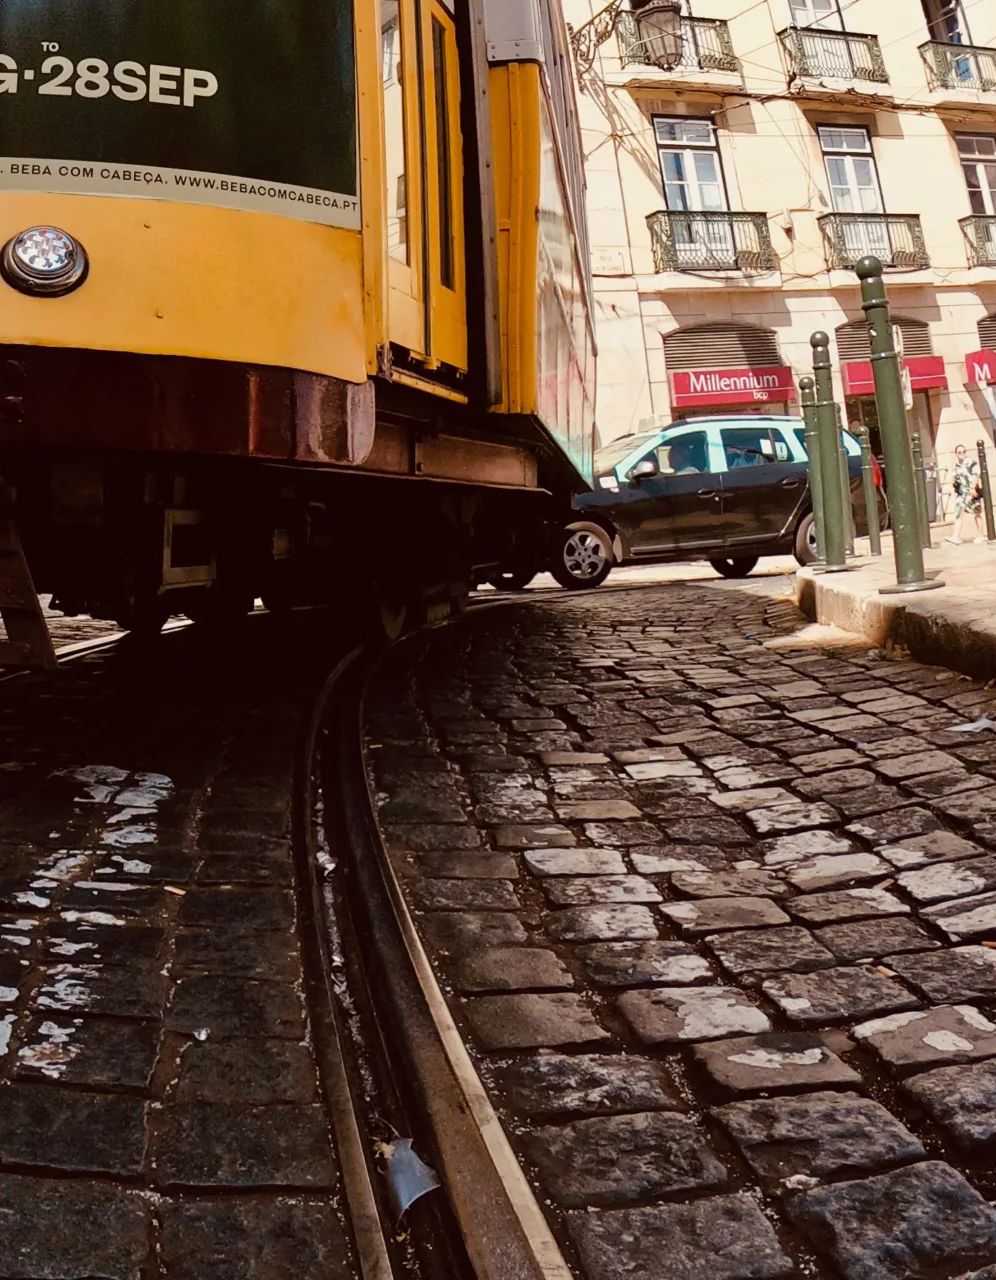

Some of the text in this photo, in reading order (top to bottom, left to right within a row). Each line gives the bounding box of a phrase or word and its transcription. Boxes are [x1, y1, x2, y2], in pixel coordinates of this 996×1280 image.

[41, 42, 59, 52] TO
[10, 163, 52, 176] BEBA
[58, 166, 94, 178] COM
[100, 168, 167, 186] CABEÇA.
[174, 174, 358, 213] WWW.BEBACOMCABECA.PT
[972, 362, 992, 381] M
[688, 371, 779, 393] Millennium
[753, 390, 769, 401] bcp
